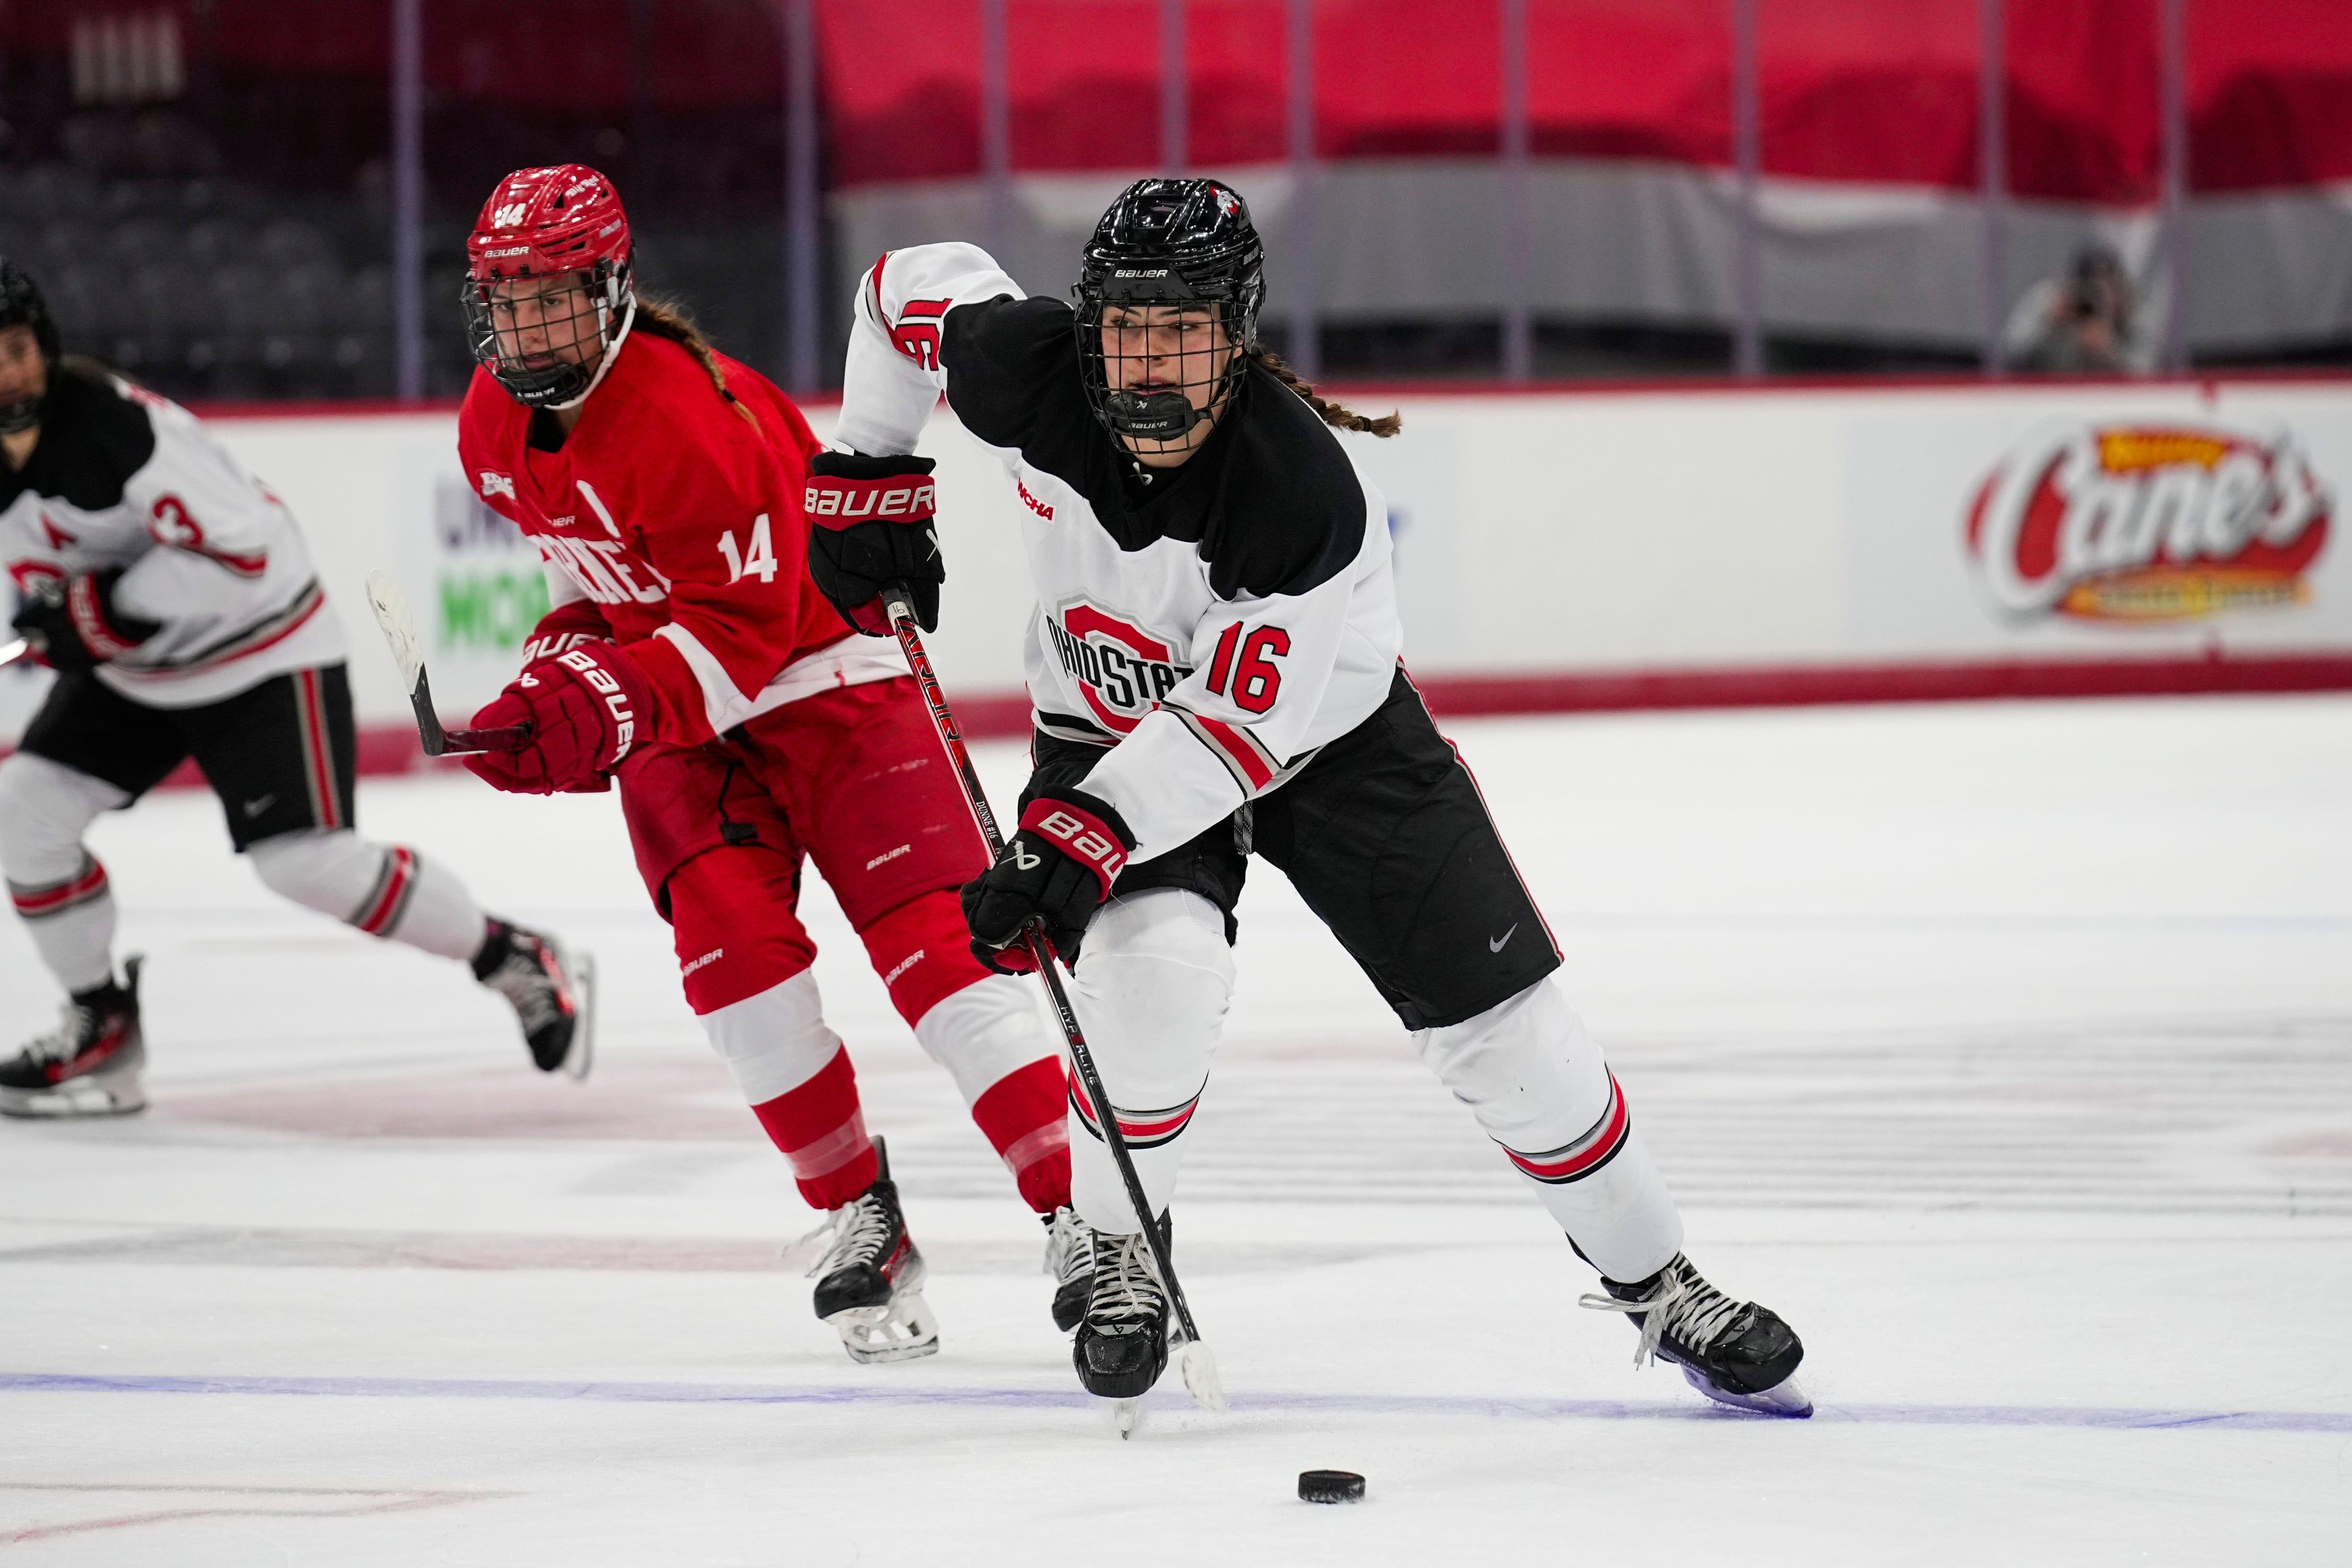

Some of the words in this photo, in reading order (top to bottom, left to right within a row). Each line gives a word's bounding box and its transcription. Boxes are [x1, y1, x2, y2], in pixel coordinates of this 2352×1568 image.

[485, 246, 529, 258] BAUER
[804, 485, 934, 516] BAUER
[717, 513, 778, 585] 14
[1046, 615, 1102, 688] OHIO
[1206, 620, 1291, 714] 16
[976, 801, 993, 826] DUNNE
[986, 827, 998, 839] #16
[867, 844, 911, 871] BAUER
[1037, 811, 1125, 884] BAU
[684, 948, 723, 977] AUER
[885, 949, 925, 986] AUER
